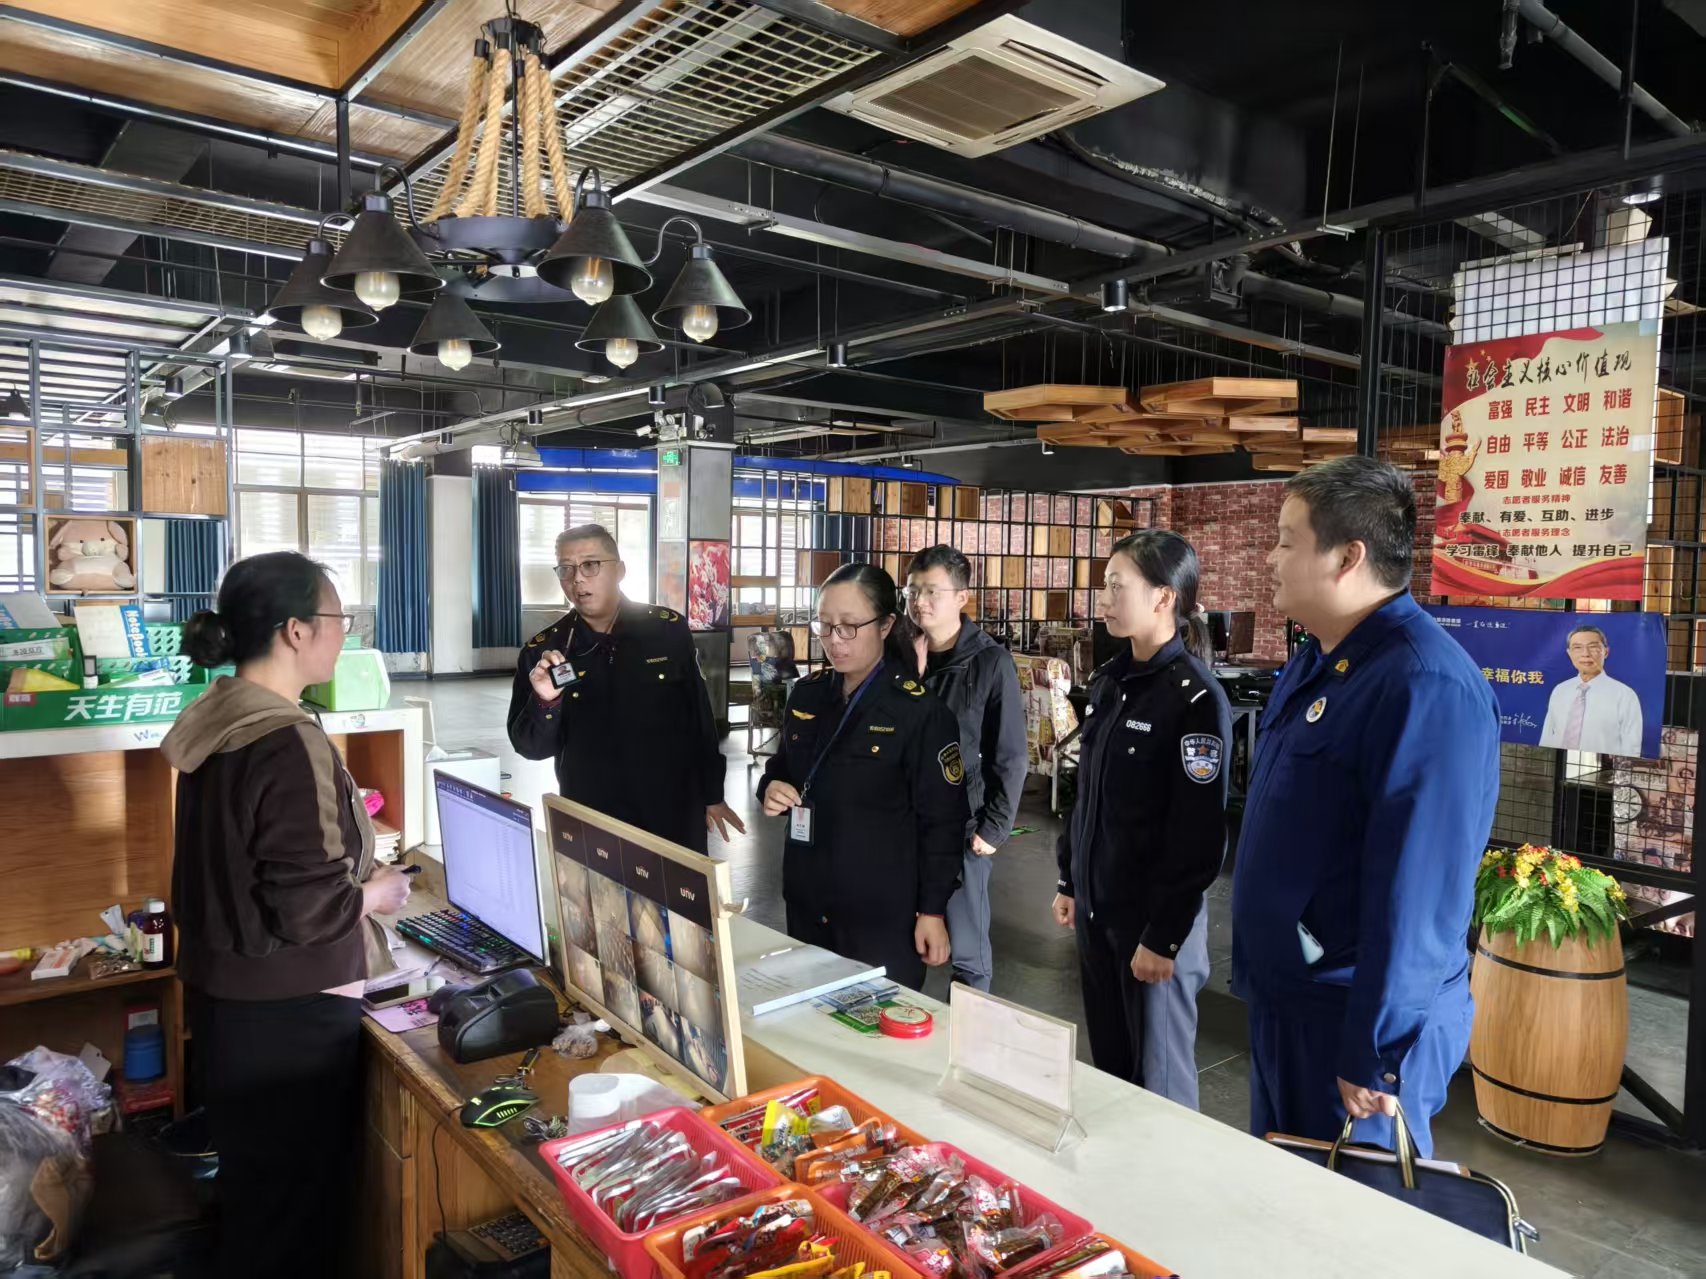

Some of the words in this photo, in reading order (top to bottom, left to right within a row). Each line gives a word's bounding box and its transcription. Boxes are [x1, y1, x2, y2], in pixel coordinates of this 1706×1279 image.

[1488, 400, 1513, 420] 富强
[1525, 396, 1550, 417] 民主
[1563, 392, 1590, 413] 文明
[1603, 388, 1632, 410] 和谐
[1486, 435, 1511, 454] 自由
[1523, 432, 1550, 452] 平等
[1561, 429, 1588, 449] 公正
[1601, 425, 1630, 447] 法治
[1484, 470, 1509, 490] 爱国
[1521, 467, 1546, 488] 敬业
[1559, 466, 1587, 487] 诚信
[1599, 464, 1628, 485] 友善
[1502, 494, 1571, 505] 志愿者服务精神
[1459, 508, 1615, 524] 奉献、有爱、互助、进步
[1502, 527, 1571, 538] 志愿者服务理念
[1446, 544, 1499, 558] 学习雷锋
[1508, 544, 1563, 558] 奉献他人
[1572, 544, 1632, 558] 提升自己
[64, 691, 184, 721] 天生有范
